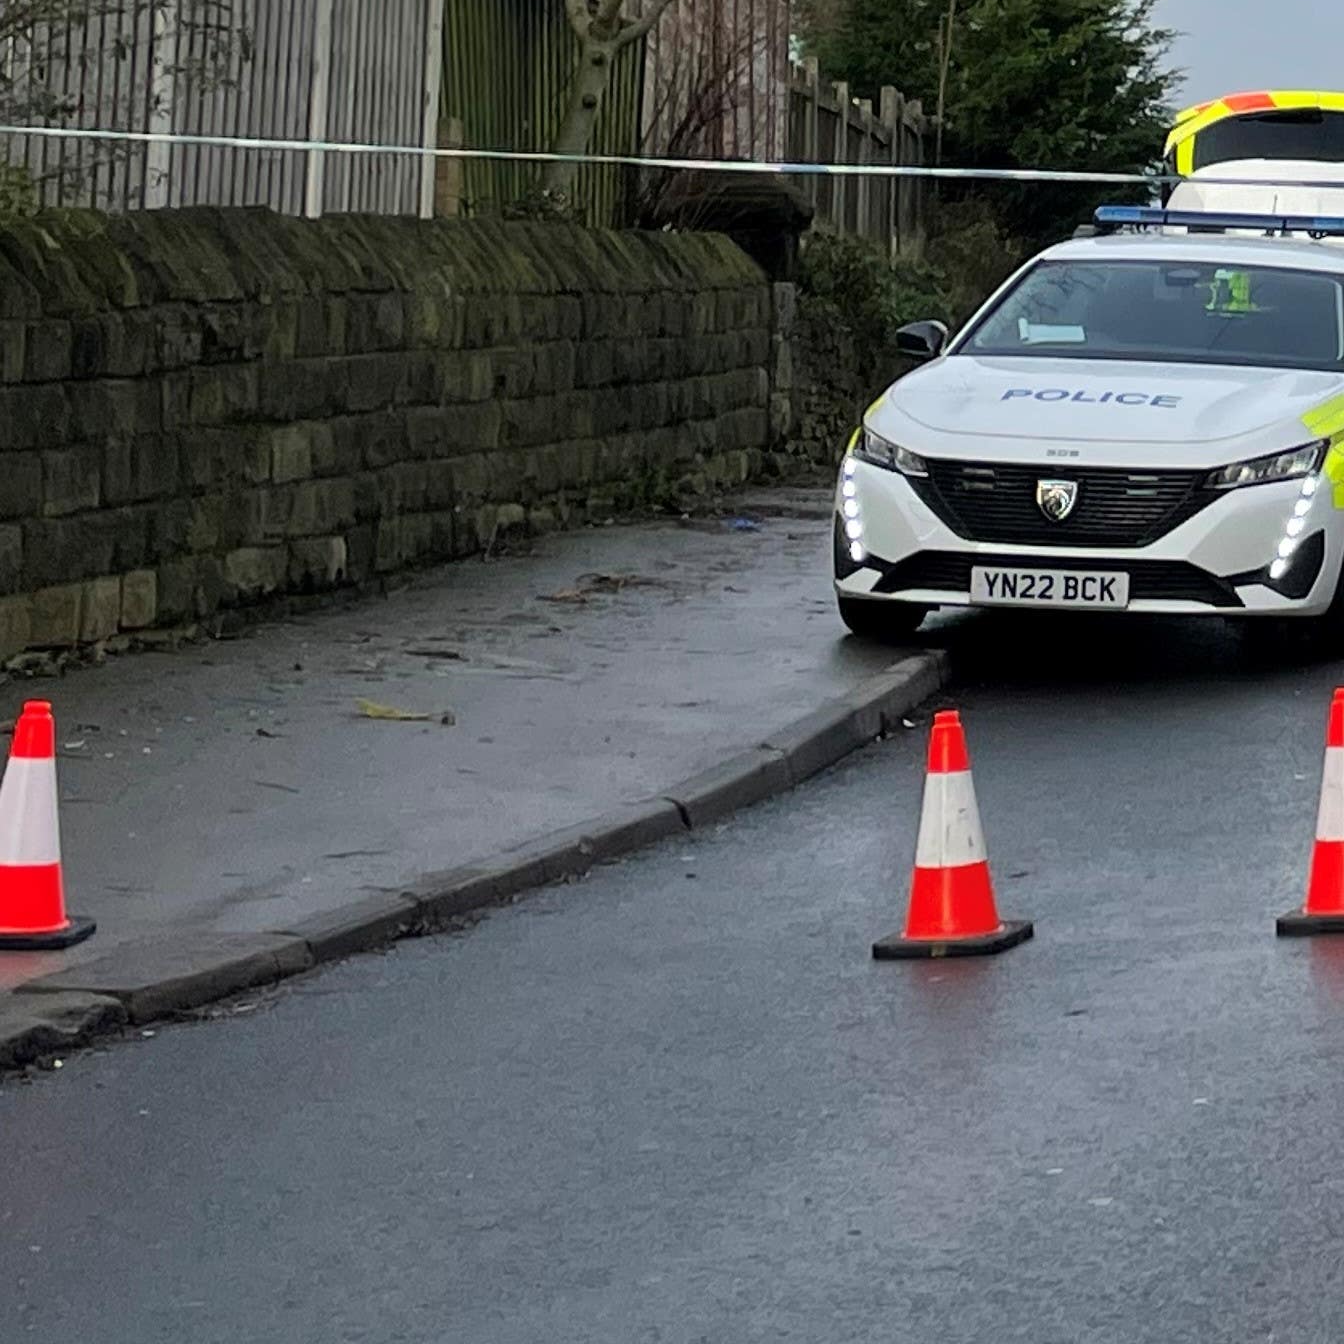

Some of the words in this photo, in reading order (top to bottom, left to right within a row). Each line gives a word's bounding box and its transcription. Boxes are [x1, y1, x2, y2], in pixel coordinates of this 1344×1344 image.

[1000, 388, 1182, 408] POLICE
[984, 571, 1055, 599] YN22
[1062, 575, 1116, 602] BCK
